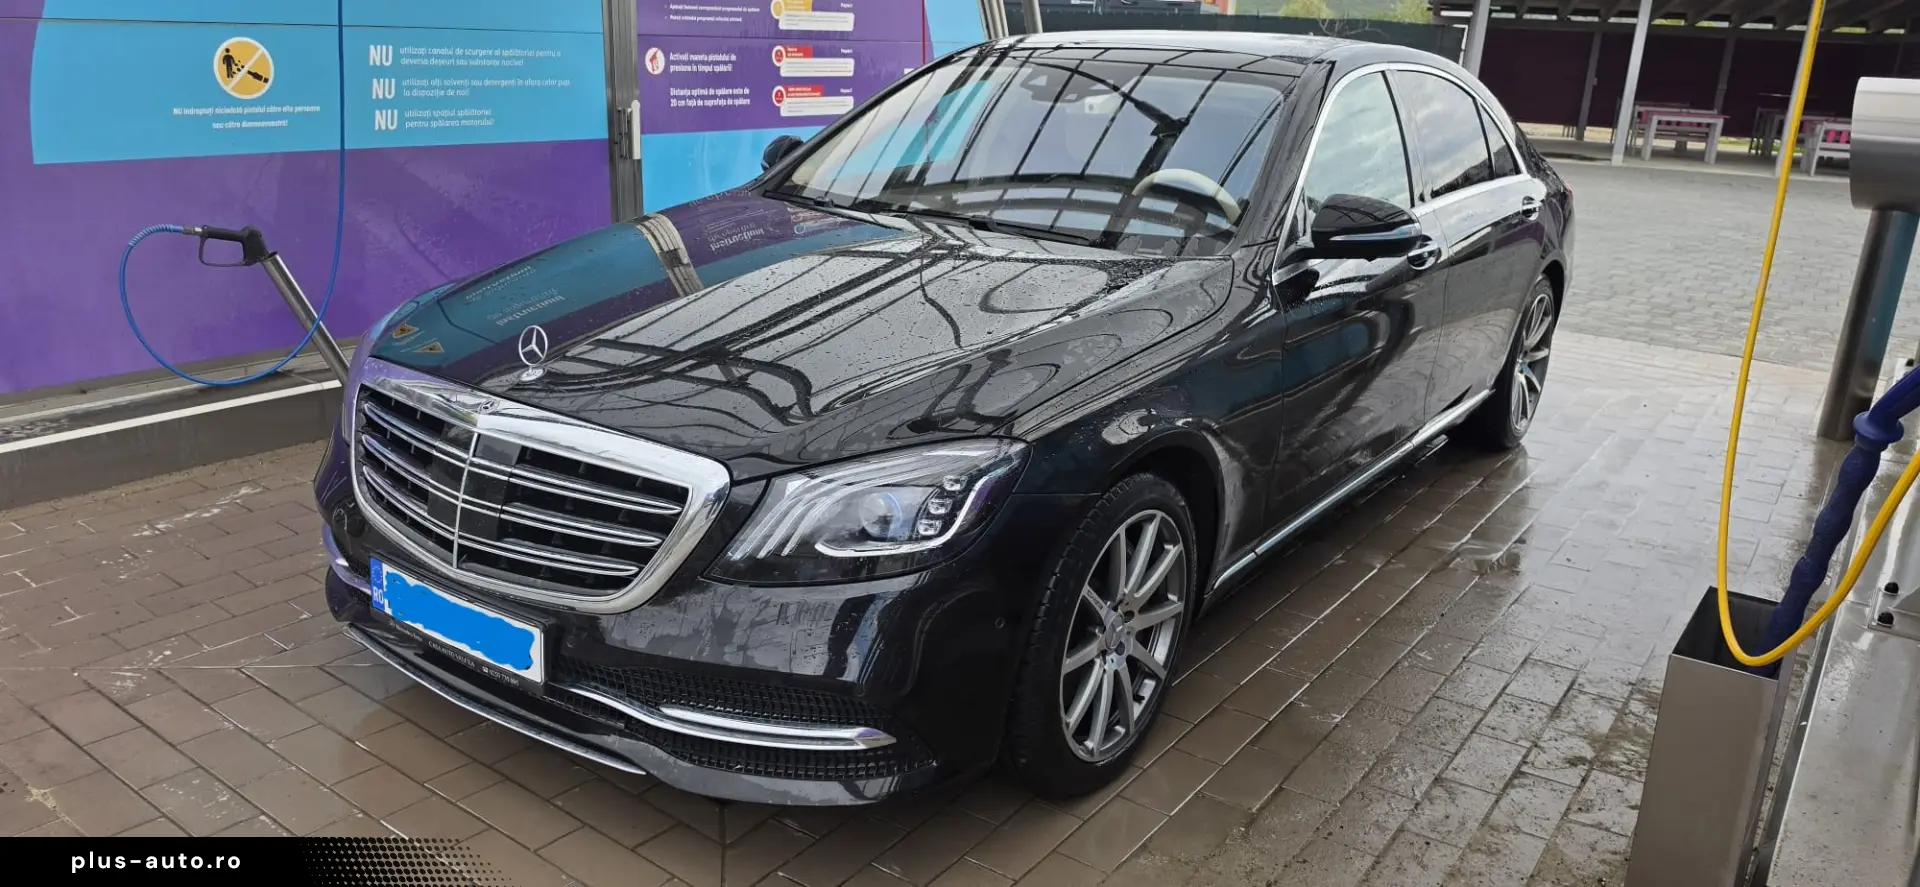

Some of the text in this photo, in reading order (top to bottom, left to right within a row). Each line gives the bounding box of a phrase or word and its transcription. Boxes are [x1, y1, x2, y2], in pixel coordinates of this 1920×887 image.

[369, 44, 393, 67] NU
[428, 47, 453, 55] canalul
[465, 49, 492, 57] scurgere
[535, 49, 555, 59] pentru
[730, 53, 737, 61] de
[400, 57, 429, 65] deversa
[698, 64, 713, 73] timpul
[371, 78, 396, 100] NU
[403, 88, 410, 96] la
[446, 88, 456, 96] de
[743, 87, 750, 95] de
[670, 98, 677, 107] 20
[697, 98, 703, 106] de
[173, 107, 183, 115] NU
[374, 109, 398, 131] NU
[405, 119, 429, 130] pentru
[373, 586, 384, 604] RO
